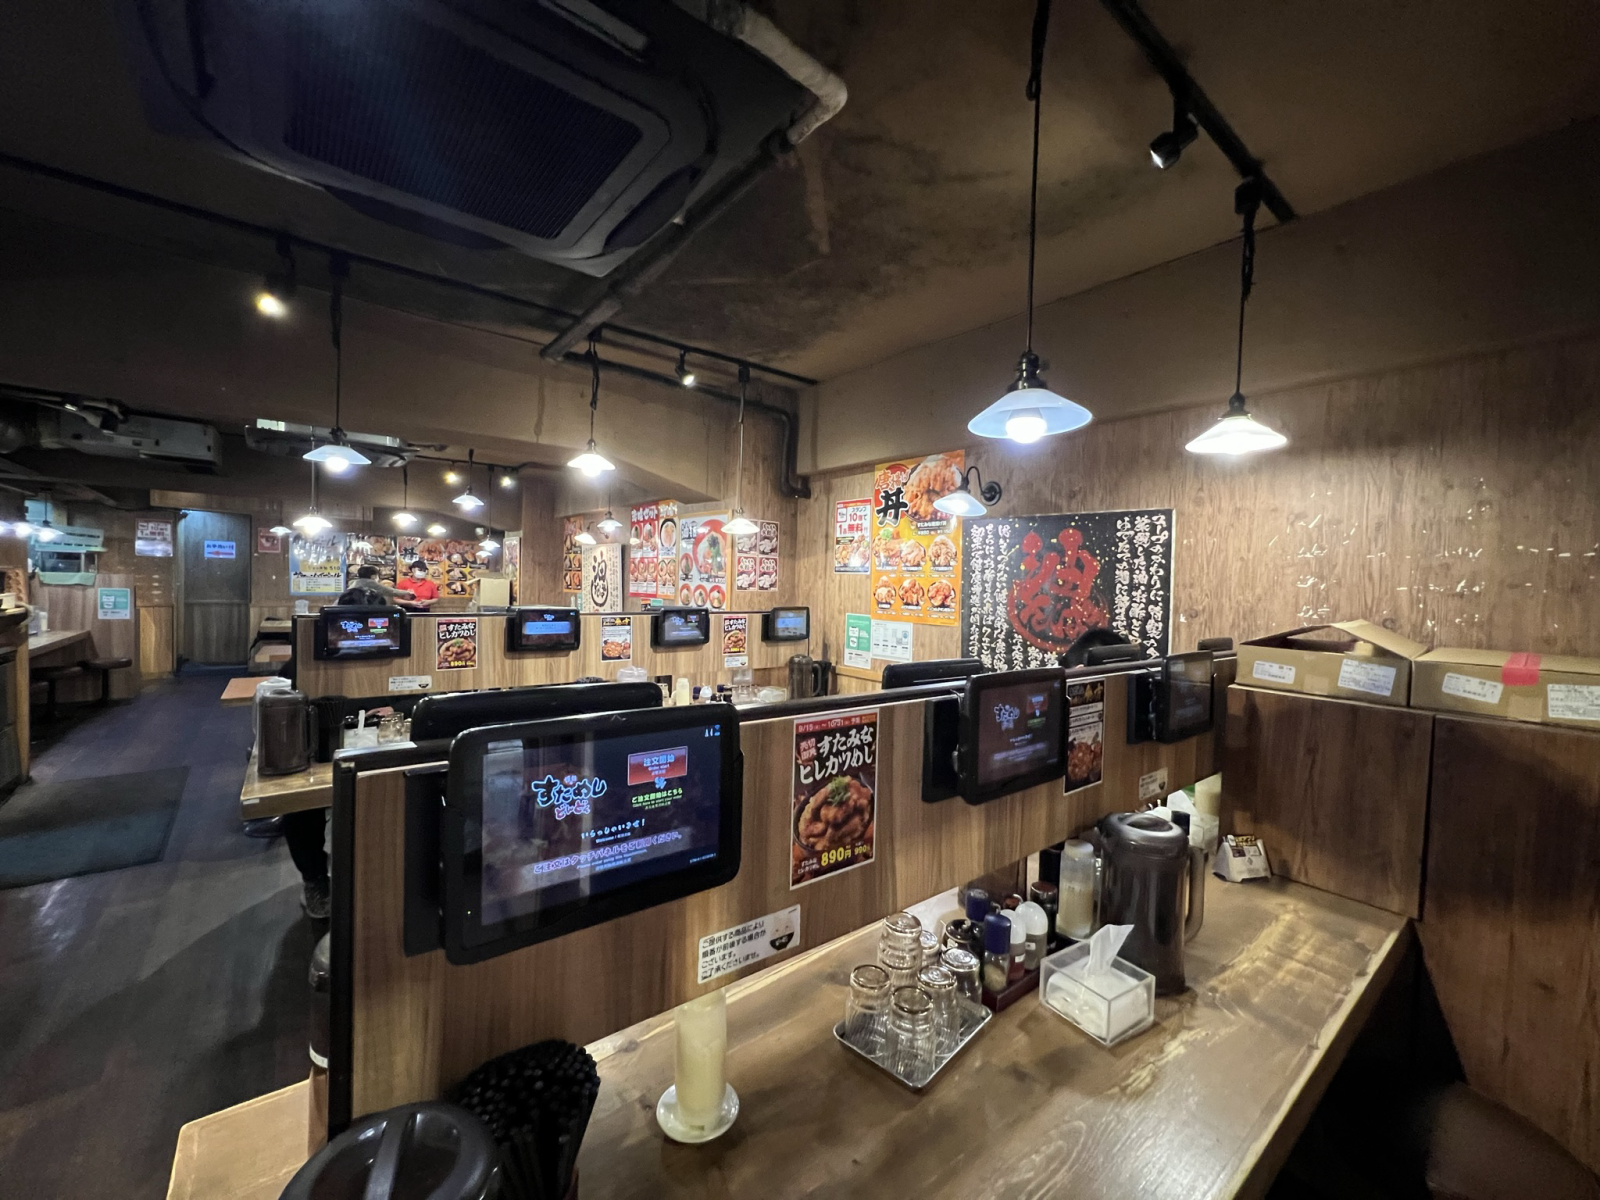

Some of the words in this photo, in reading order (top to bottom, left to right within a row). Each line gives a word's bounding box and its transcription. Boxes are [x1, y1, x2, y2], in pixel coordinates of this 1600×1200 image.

[875, 487, 909, 527] 丼
[817, 725, 874, 758] すたみな
[643, 754, 675, 767] 注文開始
[799, 745, 873, 784] ヒレカツめし
[531, 774, 607, 807] すためし
[631, 787, 683, 803] ご注文開始はこちら
[821, 846, 852, 867] 890円
[702, 920, 765, 949] ご提供する商品により
[702, 929, 766, 958] 順番が前後する場合が
